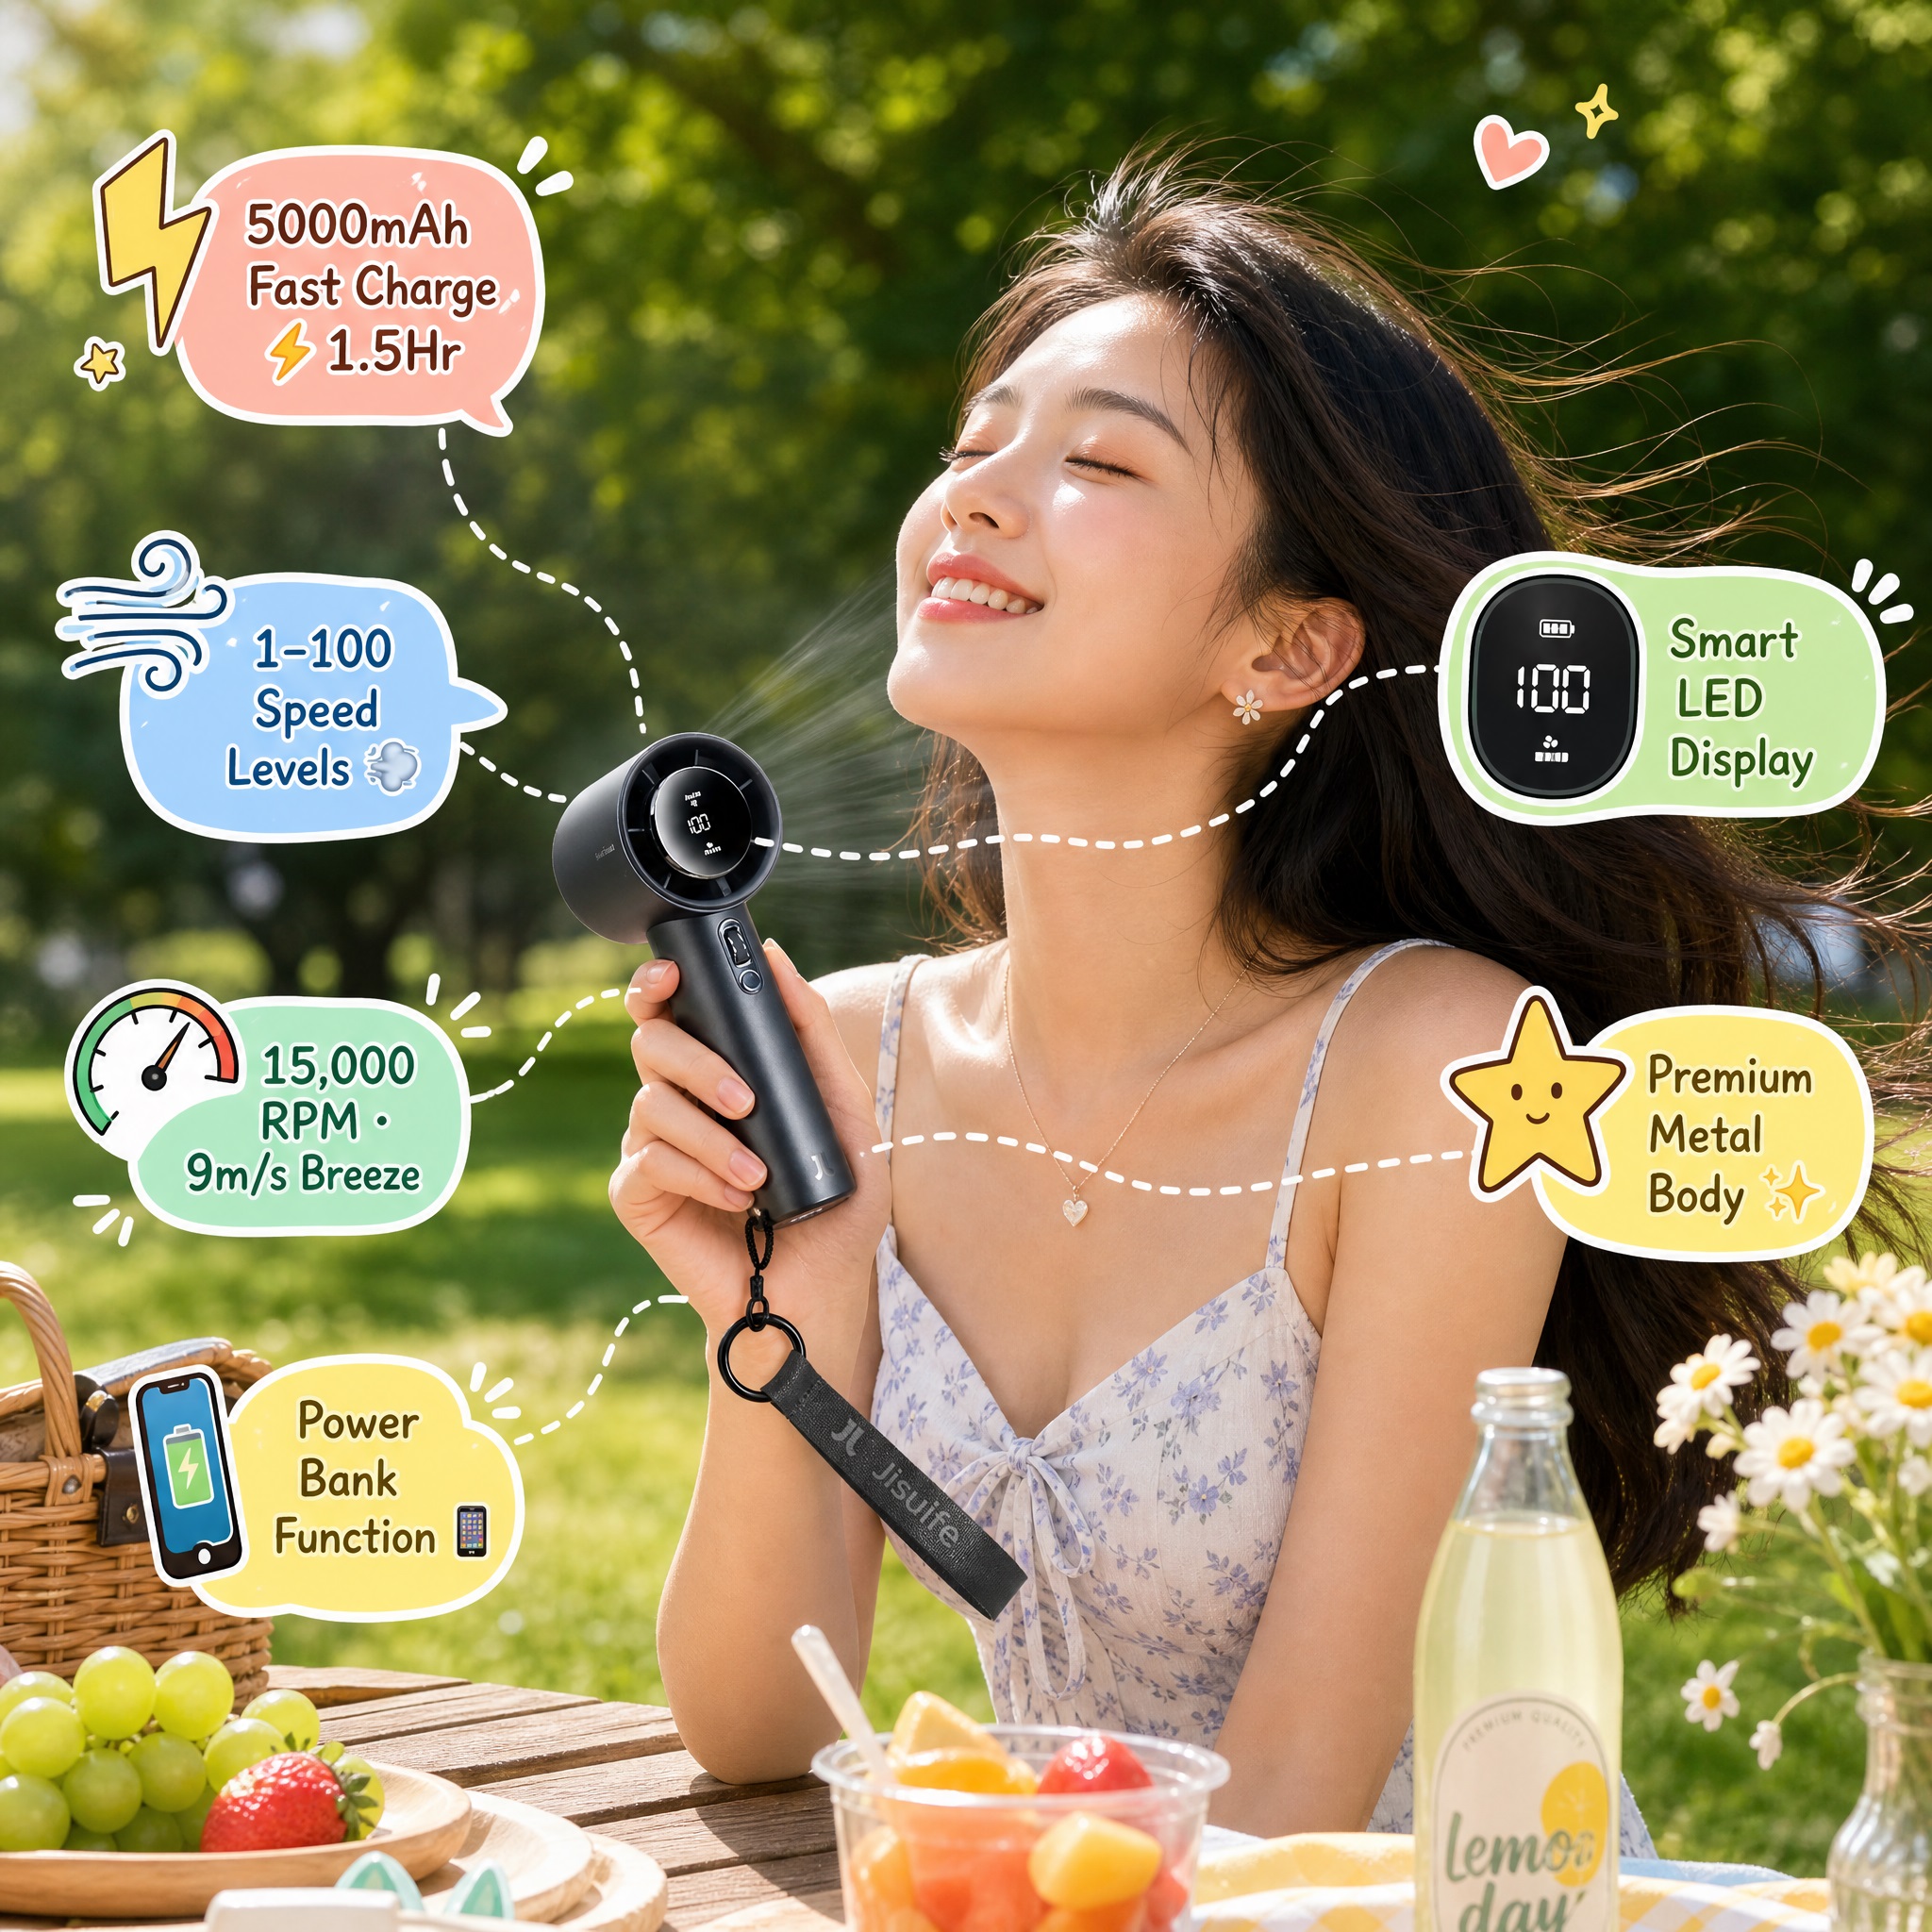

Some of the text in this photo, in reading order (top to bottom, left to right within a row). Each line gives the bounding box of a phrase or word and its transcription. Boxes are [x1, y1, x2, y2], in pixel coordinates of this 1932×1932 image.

[687, 812, 712, 835] 100
[1462, 1709, 1587, 1752] PREMIUM QUALITY
